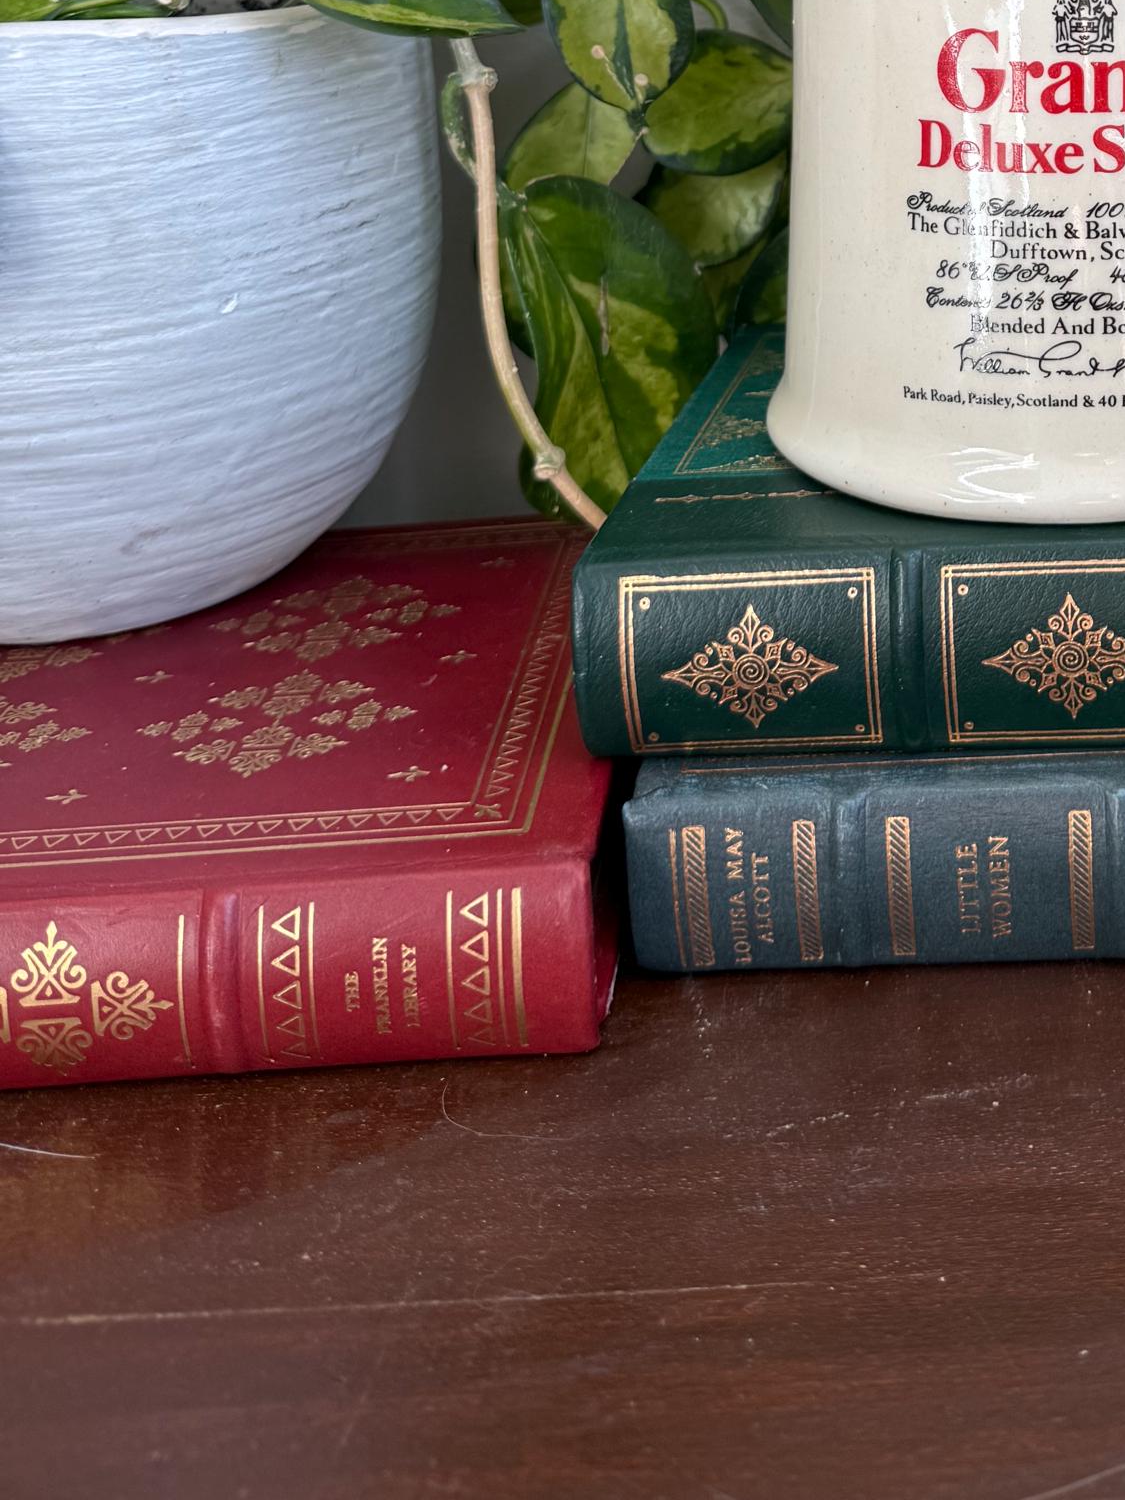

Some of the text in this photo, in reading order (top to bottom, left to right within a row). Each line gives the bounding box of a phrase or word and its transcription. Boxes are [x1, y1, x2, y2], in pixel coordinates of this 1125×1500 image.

[916, 118, 1085, 175] Deluxe
[906, 191, 968, 216] Product
[986, 197, 1069, 219] Scotland
[907, 211, 939, 234] The
[943, 216, 1057, 240] Glenfiddich
[1064, 222, 1081, 240] &
[990, 239, 1096, 263] Dufftown,
[970, 314, 1046, 335] Blended
[1051, 317, 1096, 335] And
[903, 386, 928, 401] Park
[930, 388, 966, 406] Road,
[968, 392, 1015, 409] Paisley,
[1016, 394, 1078, 408] Scotland
[1083, 395, 1096, 408] &
[1098, 394, 1118, 408] 40
[724, 827, 753, 964] LOUISA MAY
[751, 851, 775, 943] ALCOTT
[955, 841, 981, 934] LITTLE
[987, 835, 1013, 939] WOMEN
[344, 970, 361, 1013] THE
[371, 936, 393, 1035] FRANKLIN
